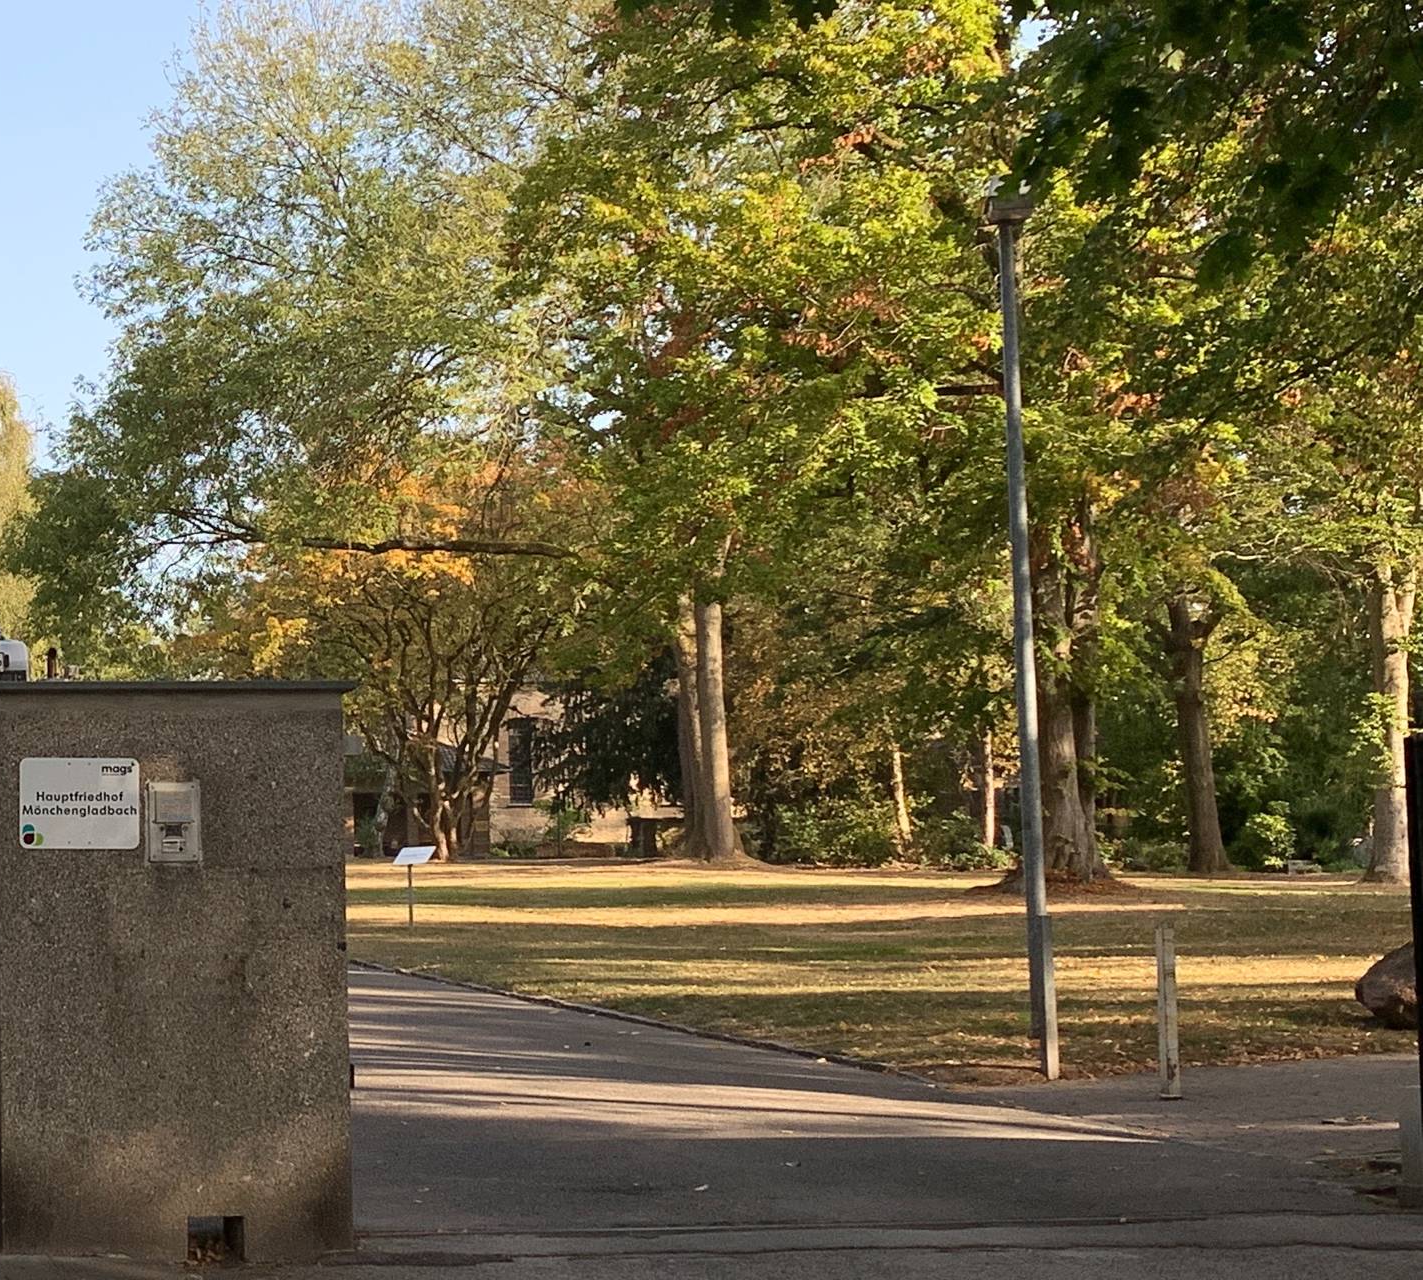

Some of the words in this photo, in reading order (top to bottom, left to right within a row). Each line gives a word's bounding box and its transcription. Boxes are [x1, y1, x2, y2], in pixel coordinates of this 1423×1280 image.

[101, 765, 132, 776] mags
[36, 791, 124, 804] Hauptfriedhof
[22, 805, 137, 817] Mönchengladbach
